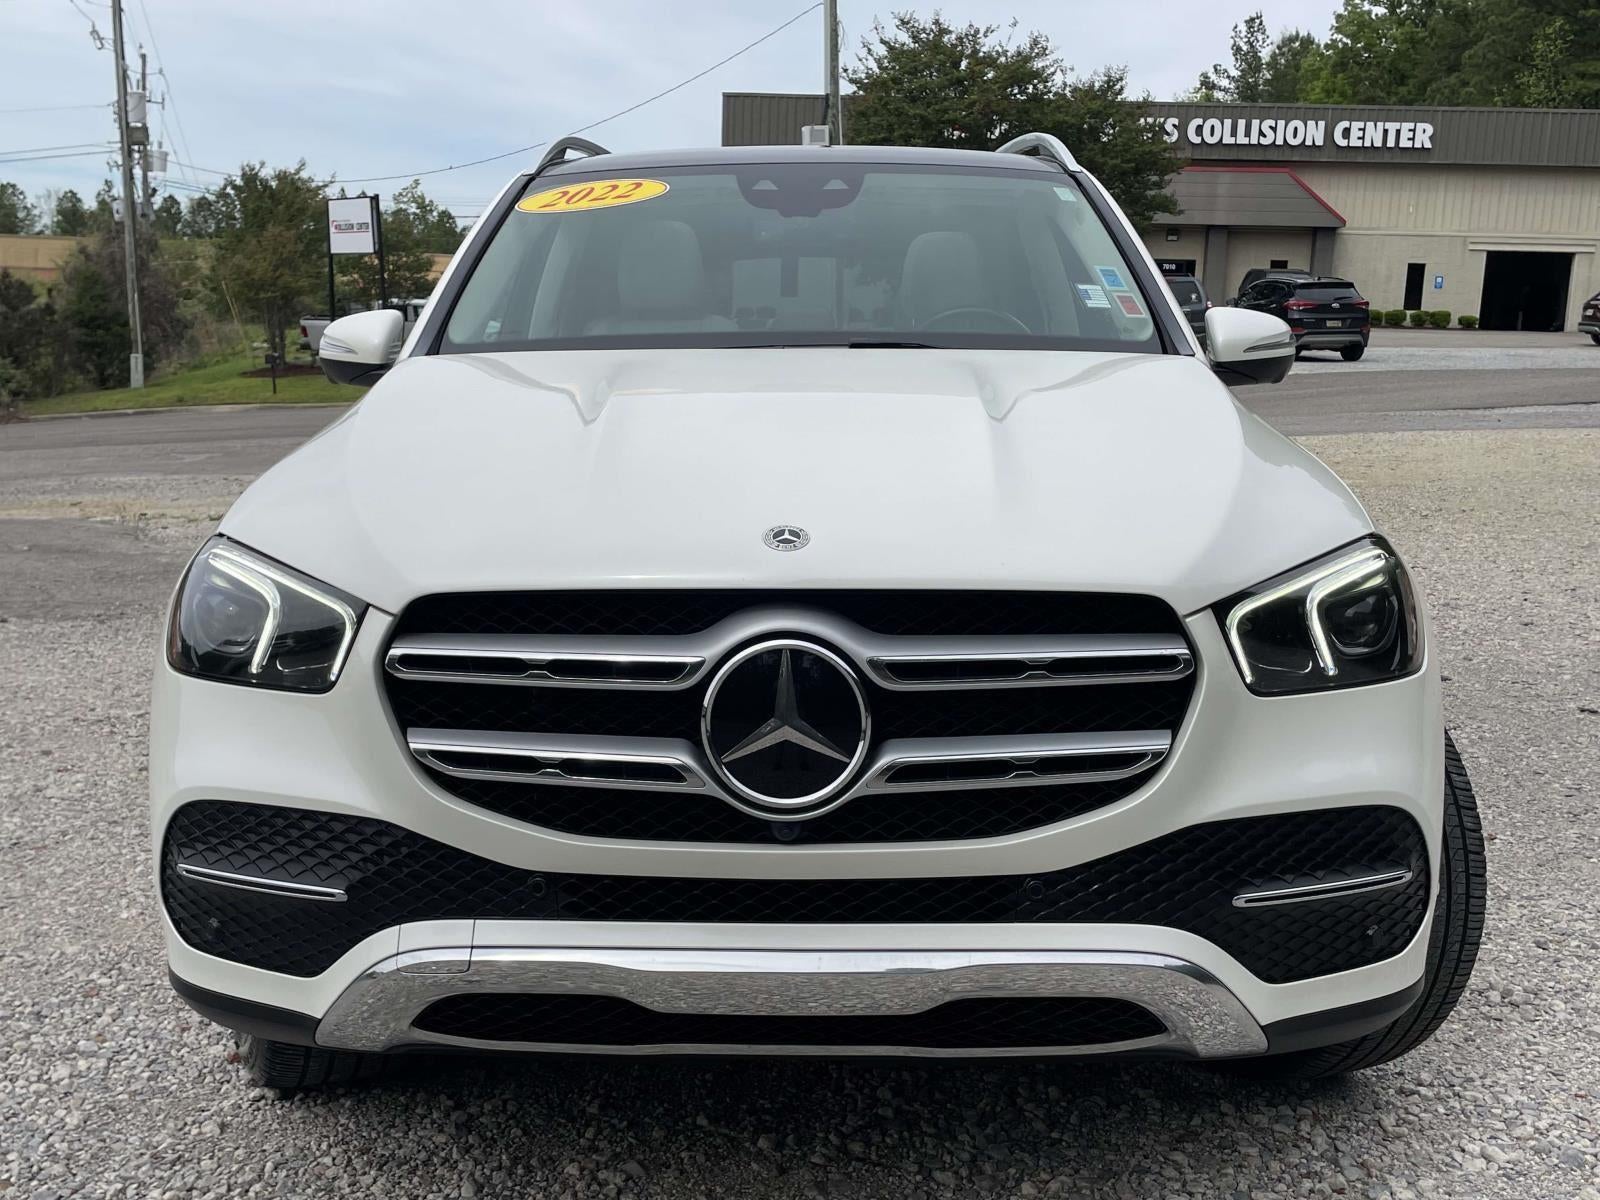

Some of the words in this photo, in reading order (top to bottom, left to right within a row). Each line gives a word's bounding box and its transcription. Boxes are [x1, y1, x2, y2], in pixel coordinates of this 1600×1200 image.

[1187, 117, 1325, 146] COLLISION
[1333, 120, 1434, 149] CENTER
[538, 181, 643, 209] 2022
